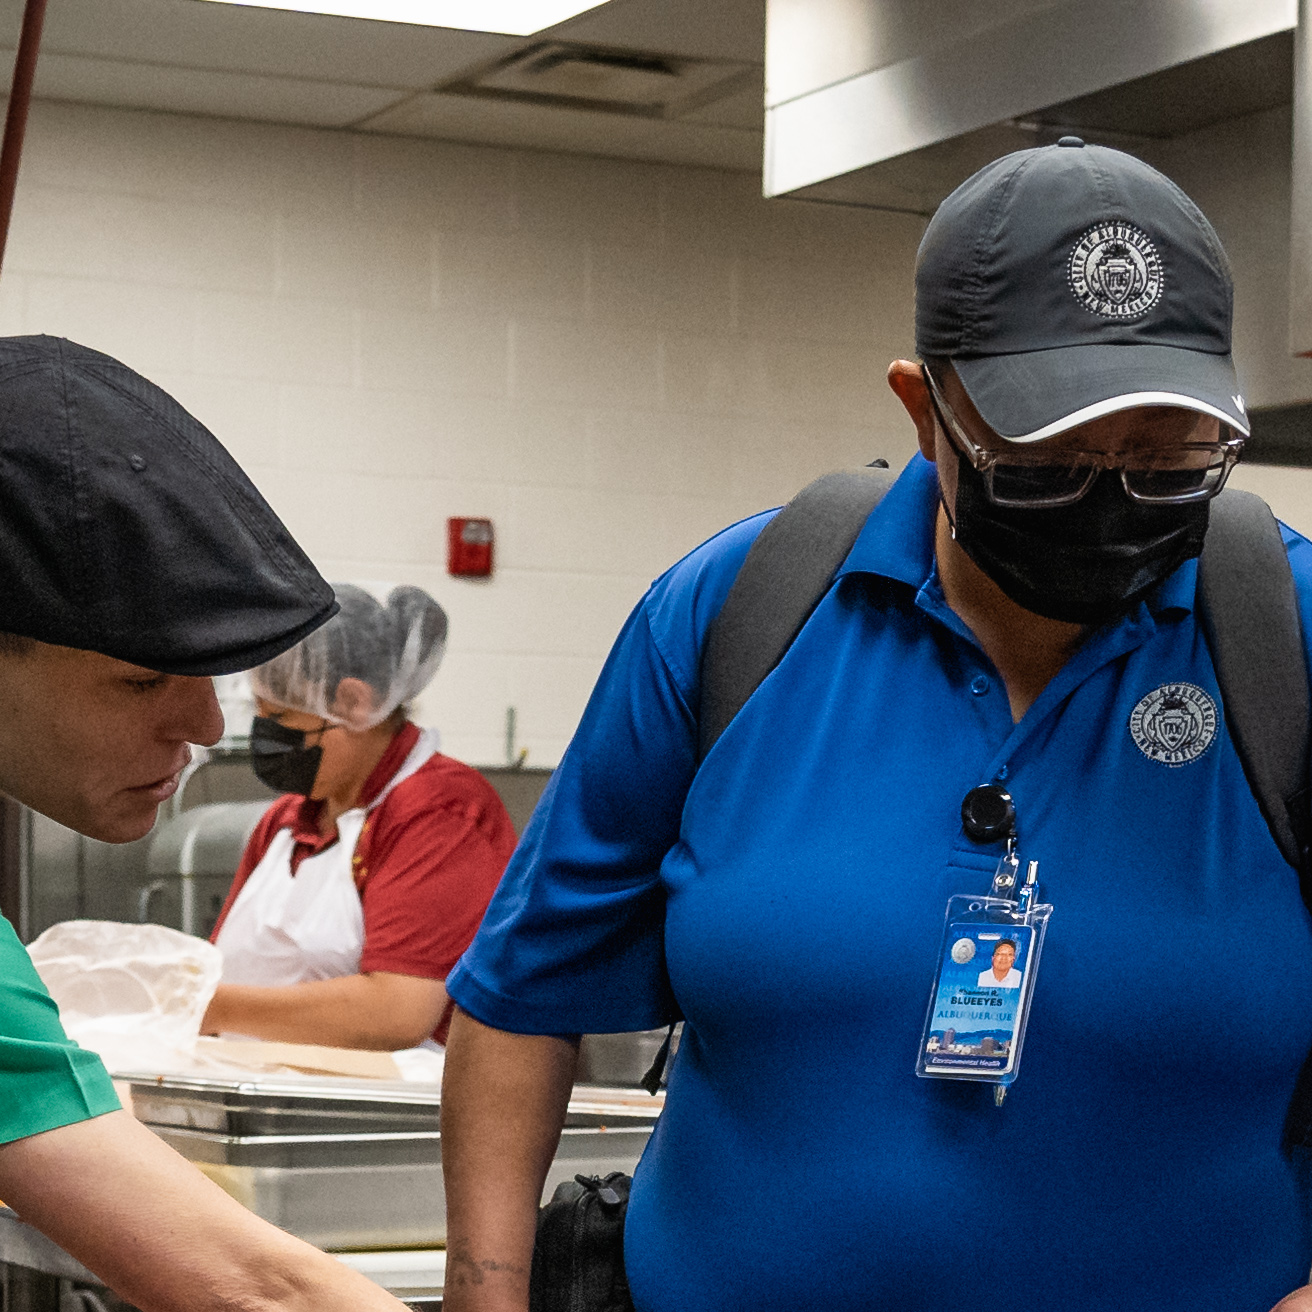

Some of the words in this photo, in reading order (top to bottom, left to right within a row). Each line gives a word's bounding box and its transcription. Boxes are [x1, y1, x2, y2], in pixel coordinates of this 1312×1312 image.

[1132, 709, 1143, 735] CITY
[1140, 693, 1155, 707] OF
[1159, 685, 1216, 736] ALBUQUERQUE
[1165, 739, 1208, 762] MEXICO
[950, 996, 1003, 1007] BLUEEYES
